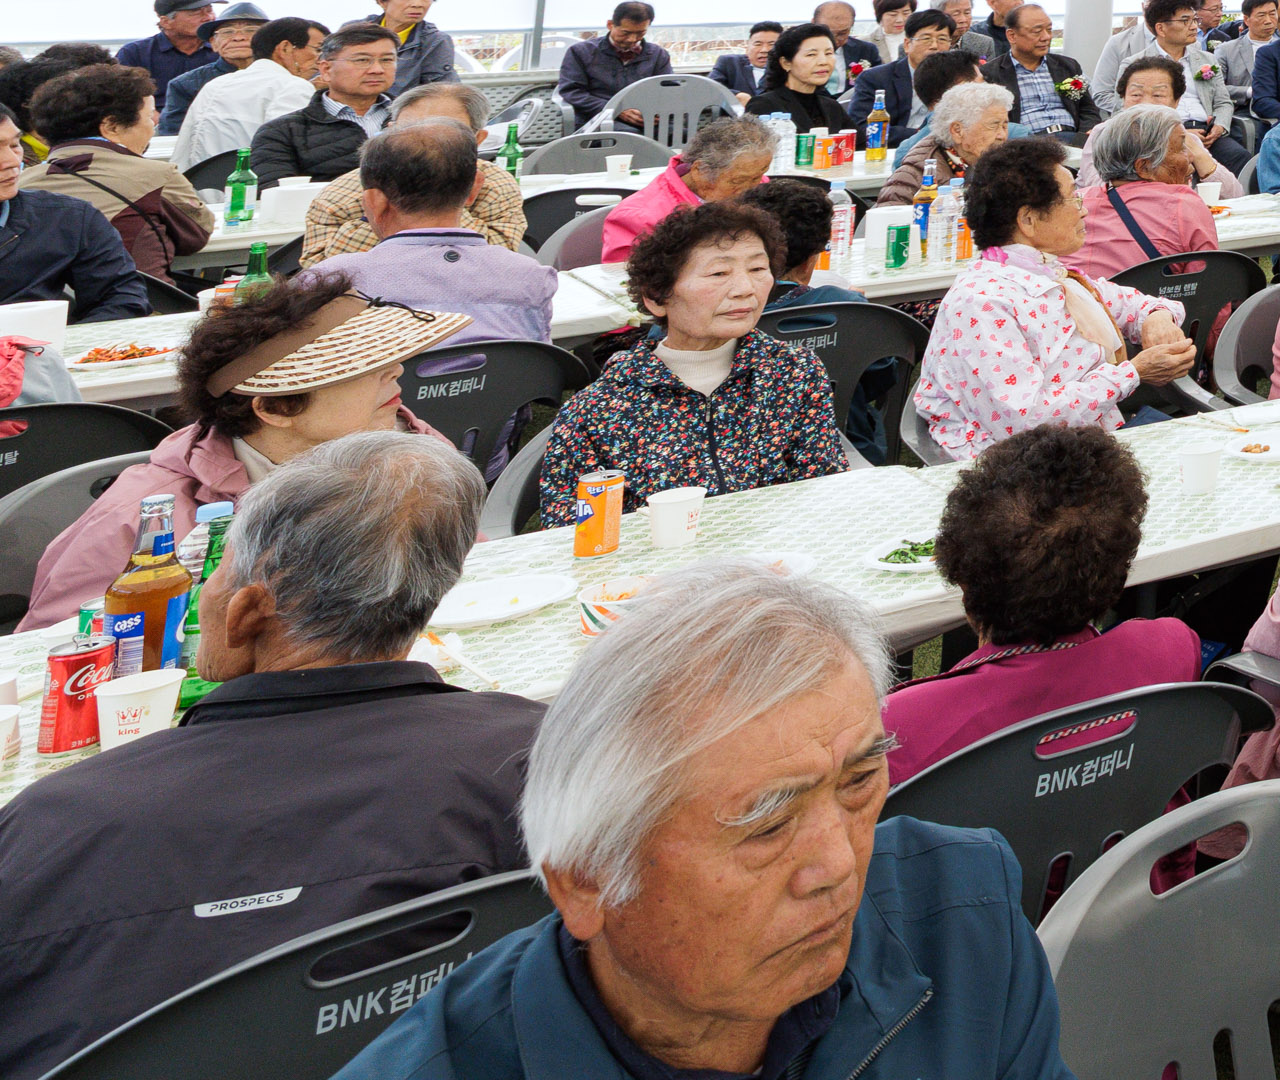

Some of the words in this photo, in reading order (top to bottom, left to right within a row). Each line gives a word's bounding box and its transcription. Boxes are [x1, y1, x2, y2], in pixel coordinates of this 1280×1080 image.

[416, 373, 488, 400] BNK컴퍼니
[117, 727, 141, 737] king
[1034, 742, 1136, 798] BNK컴퍼니
[209, 892, 284, 913] PROSPECS
